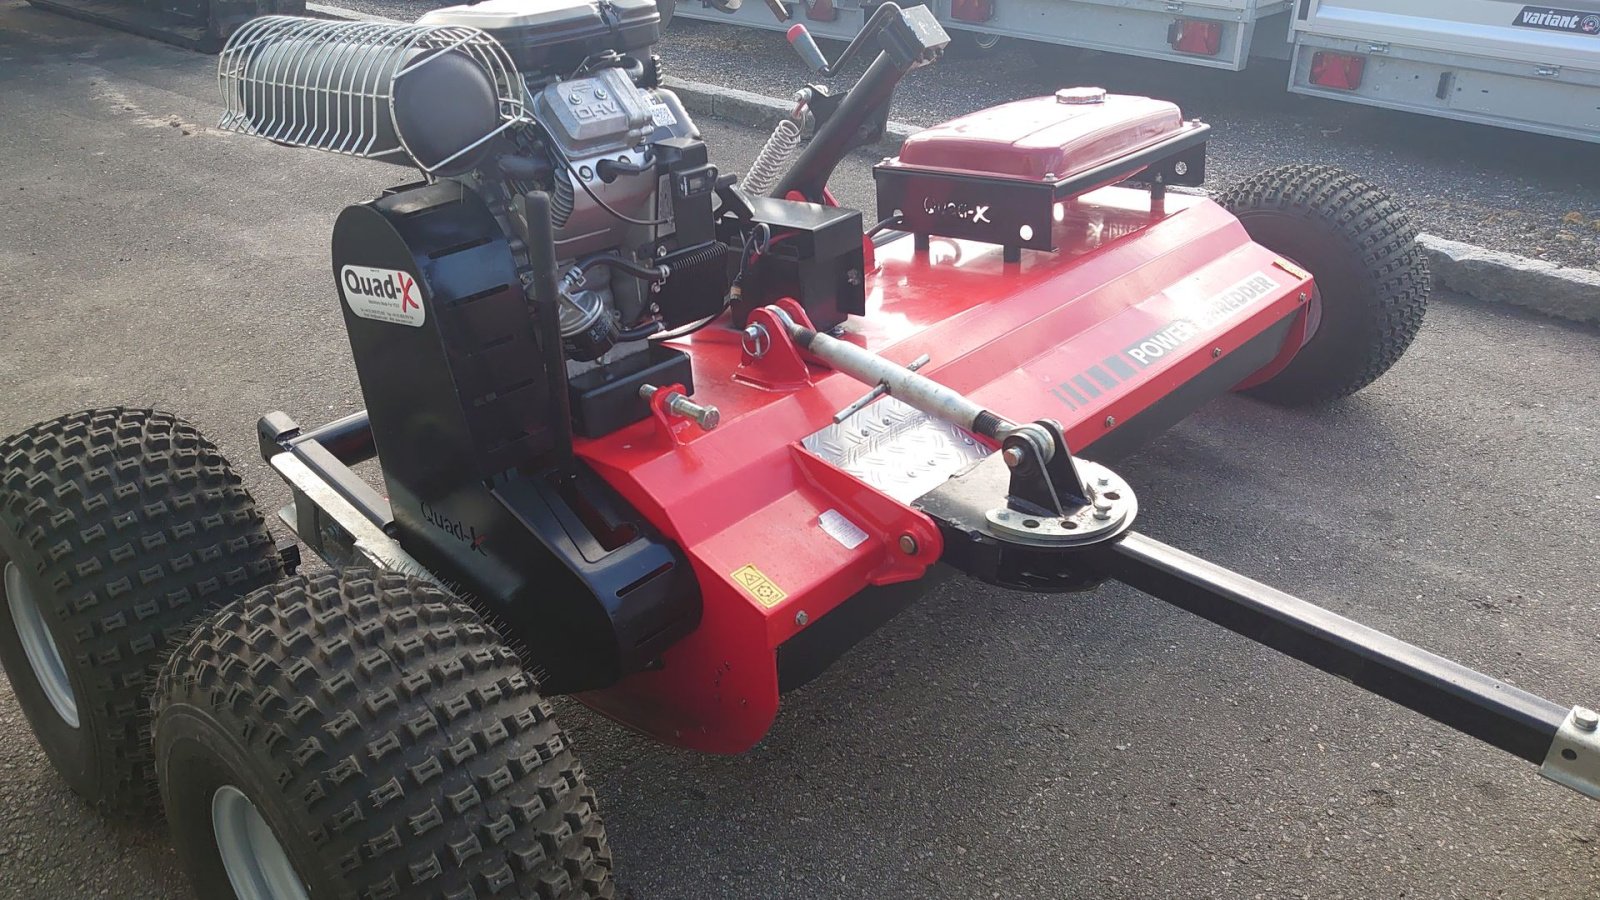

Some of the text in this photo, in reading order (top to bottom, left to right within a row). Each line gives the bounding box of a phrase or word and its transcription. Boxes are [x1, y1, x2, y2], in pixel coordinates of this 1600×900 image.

[1522, 10, 1580, 28] variant
[573, 102, 617, 120] OHV
[344, 268, 420, 313] Quad-X
[1196, 275, 1276, 326] REDDER
